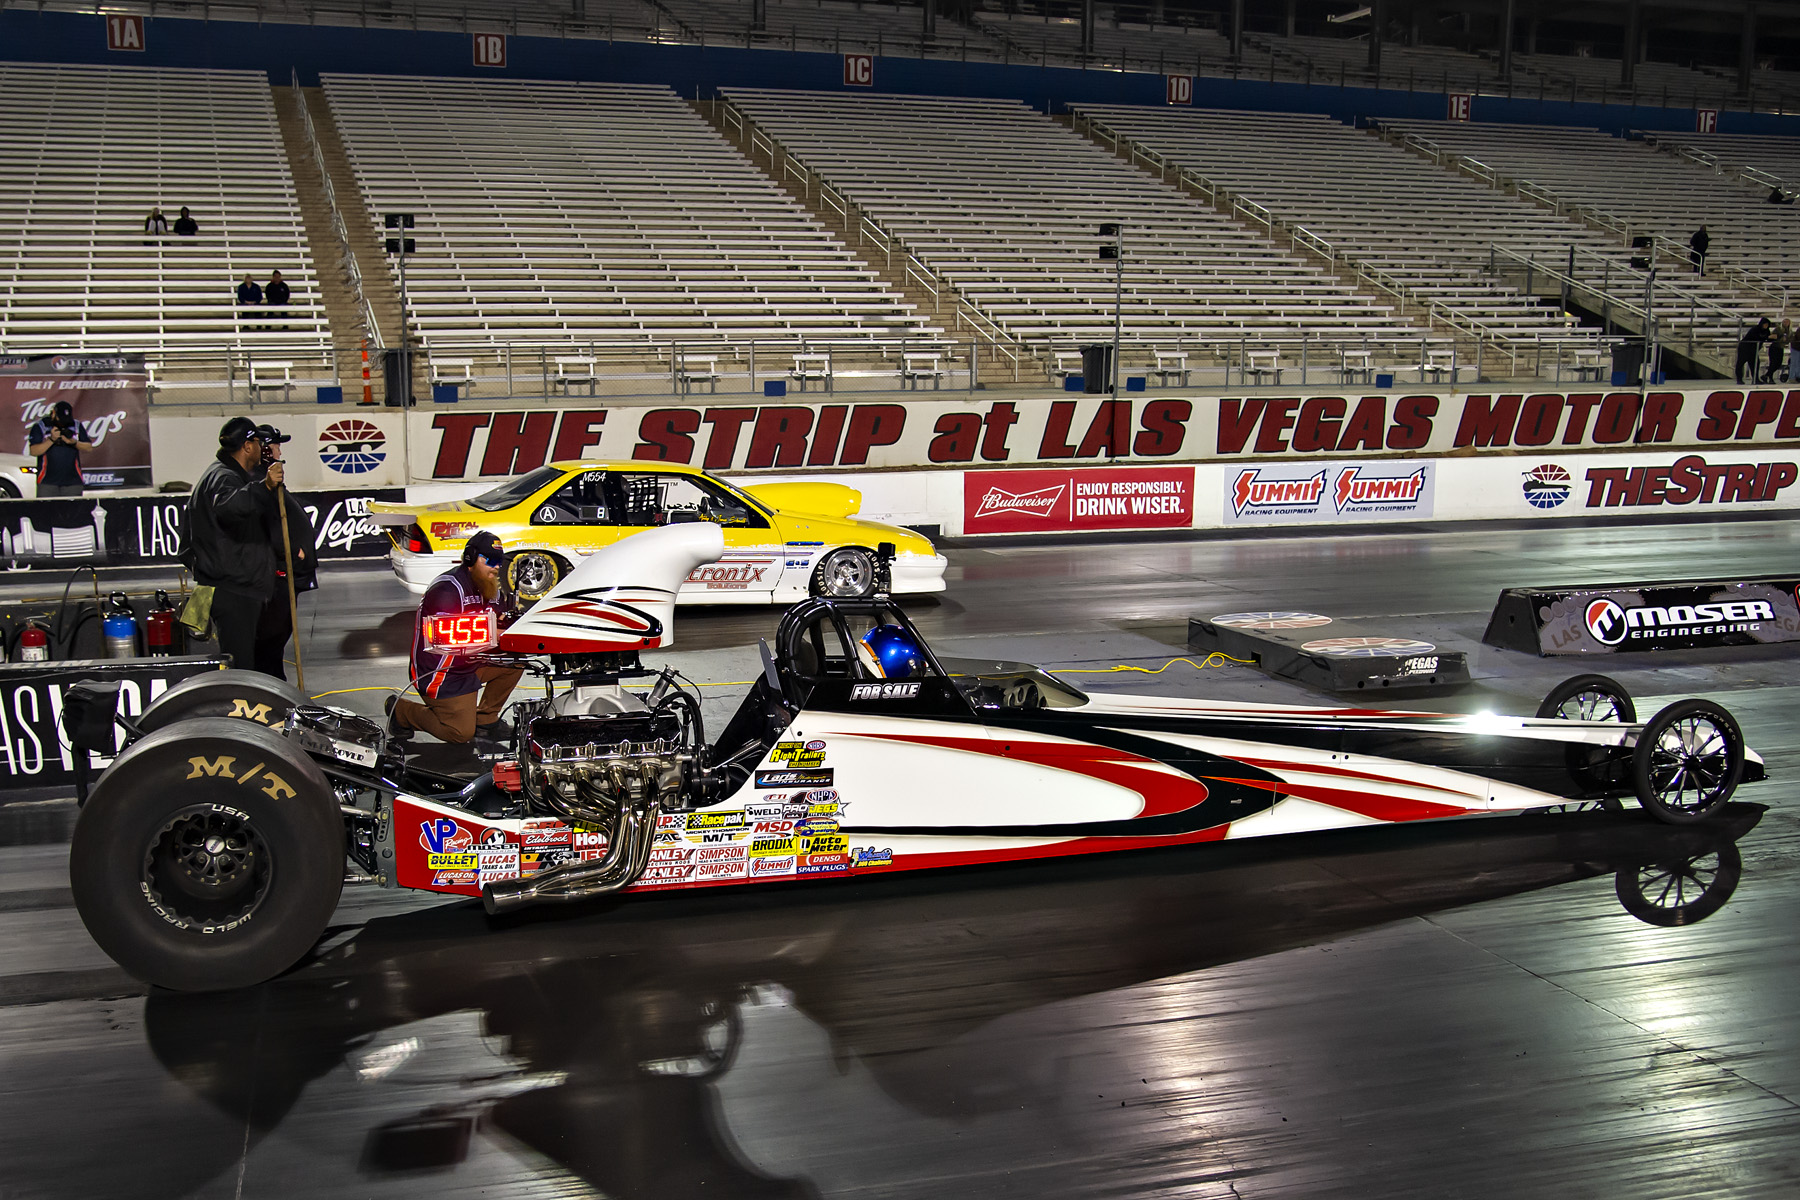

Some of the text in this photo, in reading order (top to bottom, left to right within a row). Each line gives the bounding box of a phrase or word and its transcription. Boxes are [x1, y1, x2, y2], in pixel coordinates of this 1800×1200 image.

[111, 18, 139, 48] 1A
[478, 36, 502, 63] 1B
[848, 58, 869, 82] 1C
[1171, 78, 1189, 100] 1D
[1452, 97, 1467, 118] 1E
[1700, 112, 1715, 132] 1F
[16, 381, 41, 389] RACE
[43, 381, 54, 389] IT
[59, 380, 116, 389] EXPERIENCE
[632, 403, 907, 470] STRIP
[928, 401, 1020, 463] at
[1037, 399, 1193, 459] LAS
[1216, 395, 1440, 454] VEGAS
[1453, 391, 1684, 448] MOTOR
[582, 472, 606, 482] M554
[1076, 481, 1185, 496] ENJOY RESPONSIBLY.
[982, 494, 1055, 510] Budweiser
[1076, 496, 1185, 517] DRINK WISER.
[544, 508, 553, 520] A
[597, 507, 605, 519] 8
[136, 505, 180, 556] LAS
[1628, 601, 1774, 627] MOSER
[1551, 625, 1582, 648] LAS
[1630, 623, 1760, 639] ENGINEERING
[852, 684, 919, 699] FOR SALE
[186, 755, 297, 800] M/T
[212, 804, 250, 821] USA
[701, 813, 743, 826] Racepak
[754, 821, 793, 833] MSD
[421, 819, 457, 853] VP
[525, 834, 568, 844] Edelbrock
[703, 833, 736, 843] M/T
[752, 837, 794, 851] BRODIX
[809, 843, 847, 854] Meter
[431, 855, 476, 865] BULLET
[482, 855, 517, 864] LUCAS
[649, 849, 688, 861] ANLEY
[699, 848, 745, 860] SIMPSON
[482, 872, 517, 881] LUCAS
[699, 863, 745, 875] SIMPSON
[798, 866, 821, 874] SPARK
[822, 864, 846, 872] PLUGS
[140, 881, 190, 930] RACING
[202, 913, 252, 934] WELD
